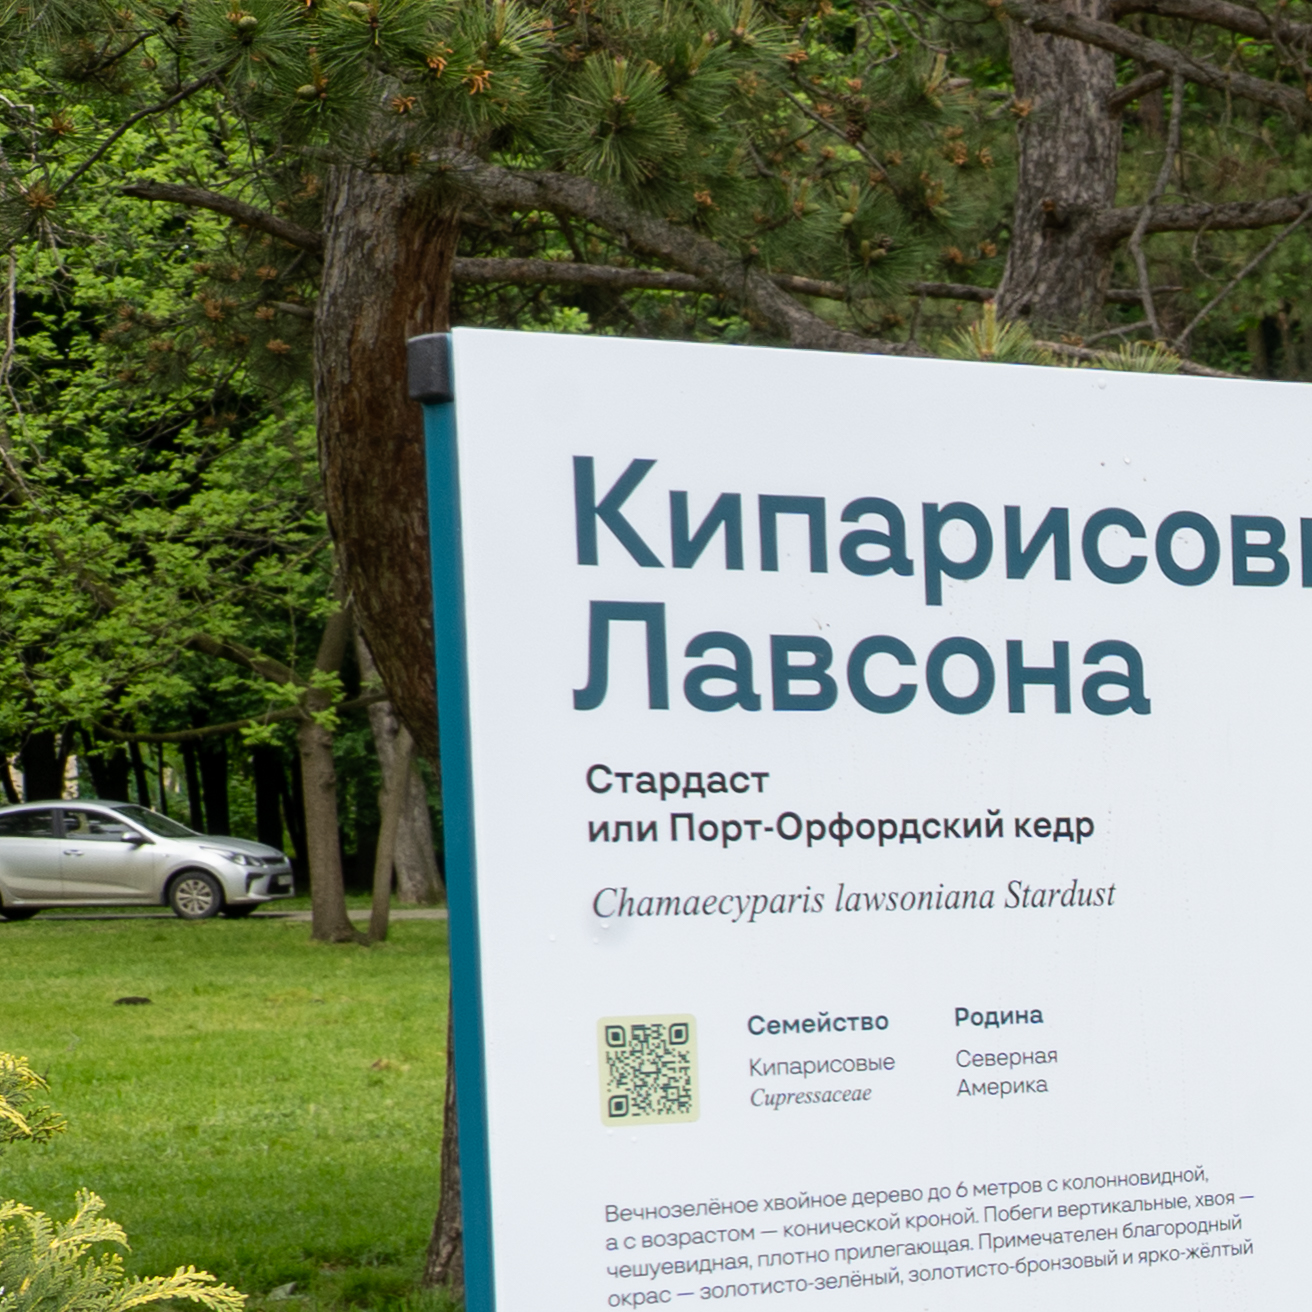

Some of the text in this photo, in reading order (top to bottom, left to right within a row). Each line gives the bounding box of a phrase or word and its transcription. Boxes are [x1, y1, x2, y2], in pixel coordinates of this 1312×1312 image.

[572, 599, 1152, 715] Лавсона
[586, 764, 770, 800] Стардаст
[587, 808, 1095, 848] или Порт-Орфордский кедр
[592, 879, 1116, 923] Chamaecyparis lawsoniana Stardust
[747, 1011, 890, 1036] Семейство
[954, 1006, 1044, 1029] Родина
[748, 1055, 896, 1079] Кипарисовые
[956, 1047, 1058, 1072] Северная
[749, 1085, 872, 1110] Cupressaceae
[957, 1076, 1048, 1098] Америка
[605, 1165, 1209, 1222] Вечнозелёное хвойное дерево до 6 метров с колонновидной,
[605, 1237, 618, 1251] а
[623, 1235, 637, 1250] с
[641, 1227, 755, 1249] возрастом
[783, 1212, 901, 1237] конической
[905, 1207, 979, 1231] кроной.
[984, 1203, 1052, 1223] Побеги
[1057, 1195, 1191, 1219] вертикальные,
[1195, 1192, 1235, 1208] хвоя
[607, 1214, 1242, 1280] чешуевидная, плотно прилегающая. Примечателен благородный
[608, 1288, 671, 1309] окрас
[700, 1266, 904, 1301] золотисто-зелёный,
[908, 1250, 1118, 1281] золотисто-бронзовый
[1123, 1251, 1133, 1265] и
[1138, 1238, 1254, 1266] ярко-жёлтый
